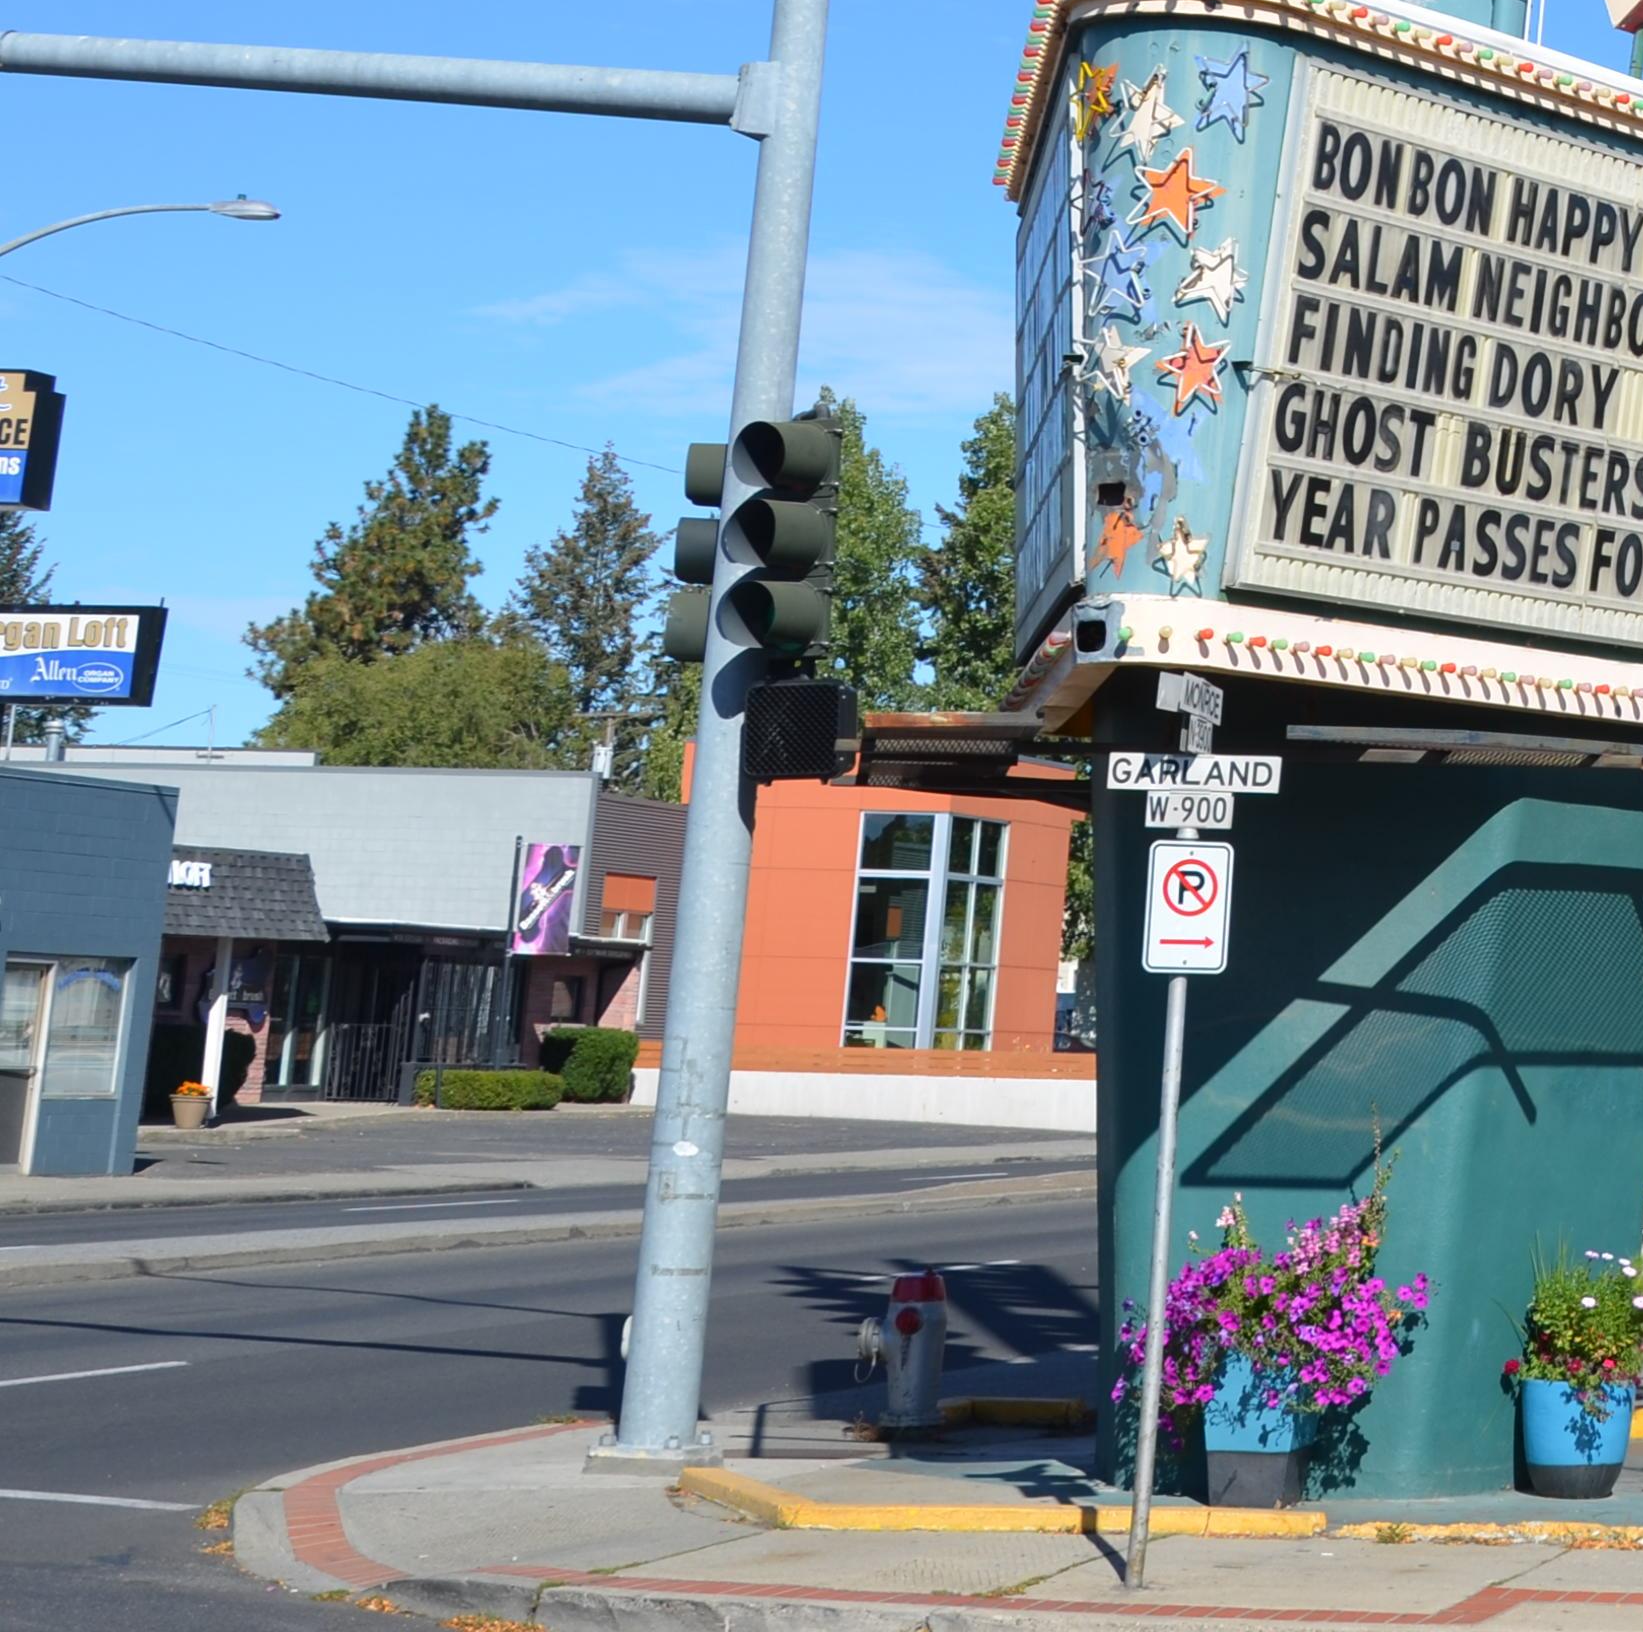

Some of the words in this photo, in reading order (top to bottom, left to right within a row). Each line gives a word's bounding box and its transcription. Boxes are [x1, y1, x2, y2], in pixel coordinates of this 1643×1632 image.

[1298, 209, 1464, 312] SALAM
[1288, 294, 1478, 400] FINDING
[1489, 342, 1620, 429] DORY
[1276, 382, 1436, 477] GHOST
[1272, 469, 1397, 559] YEAR
[1413, 497, 1580, 588] PASSES
[67, 616, 128, 648] Loft
[30, 655, 77, 683] Allen
[1184, 679, 1220, 719] MONROE
[1112, 757, 1274, 788] GARLAND
